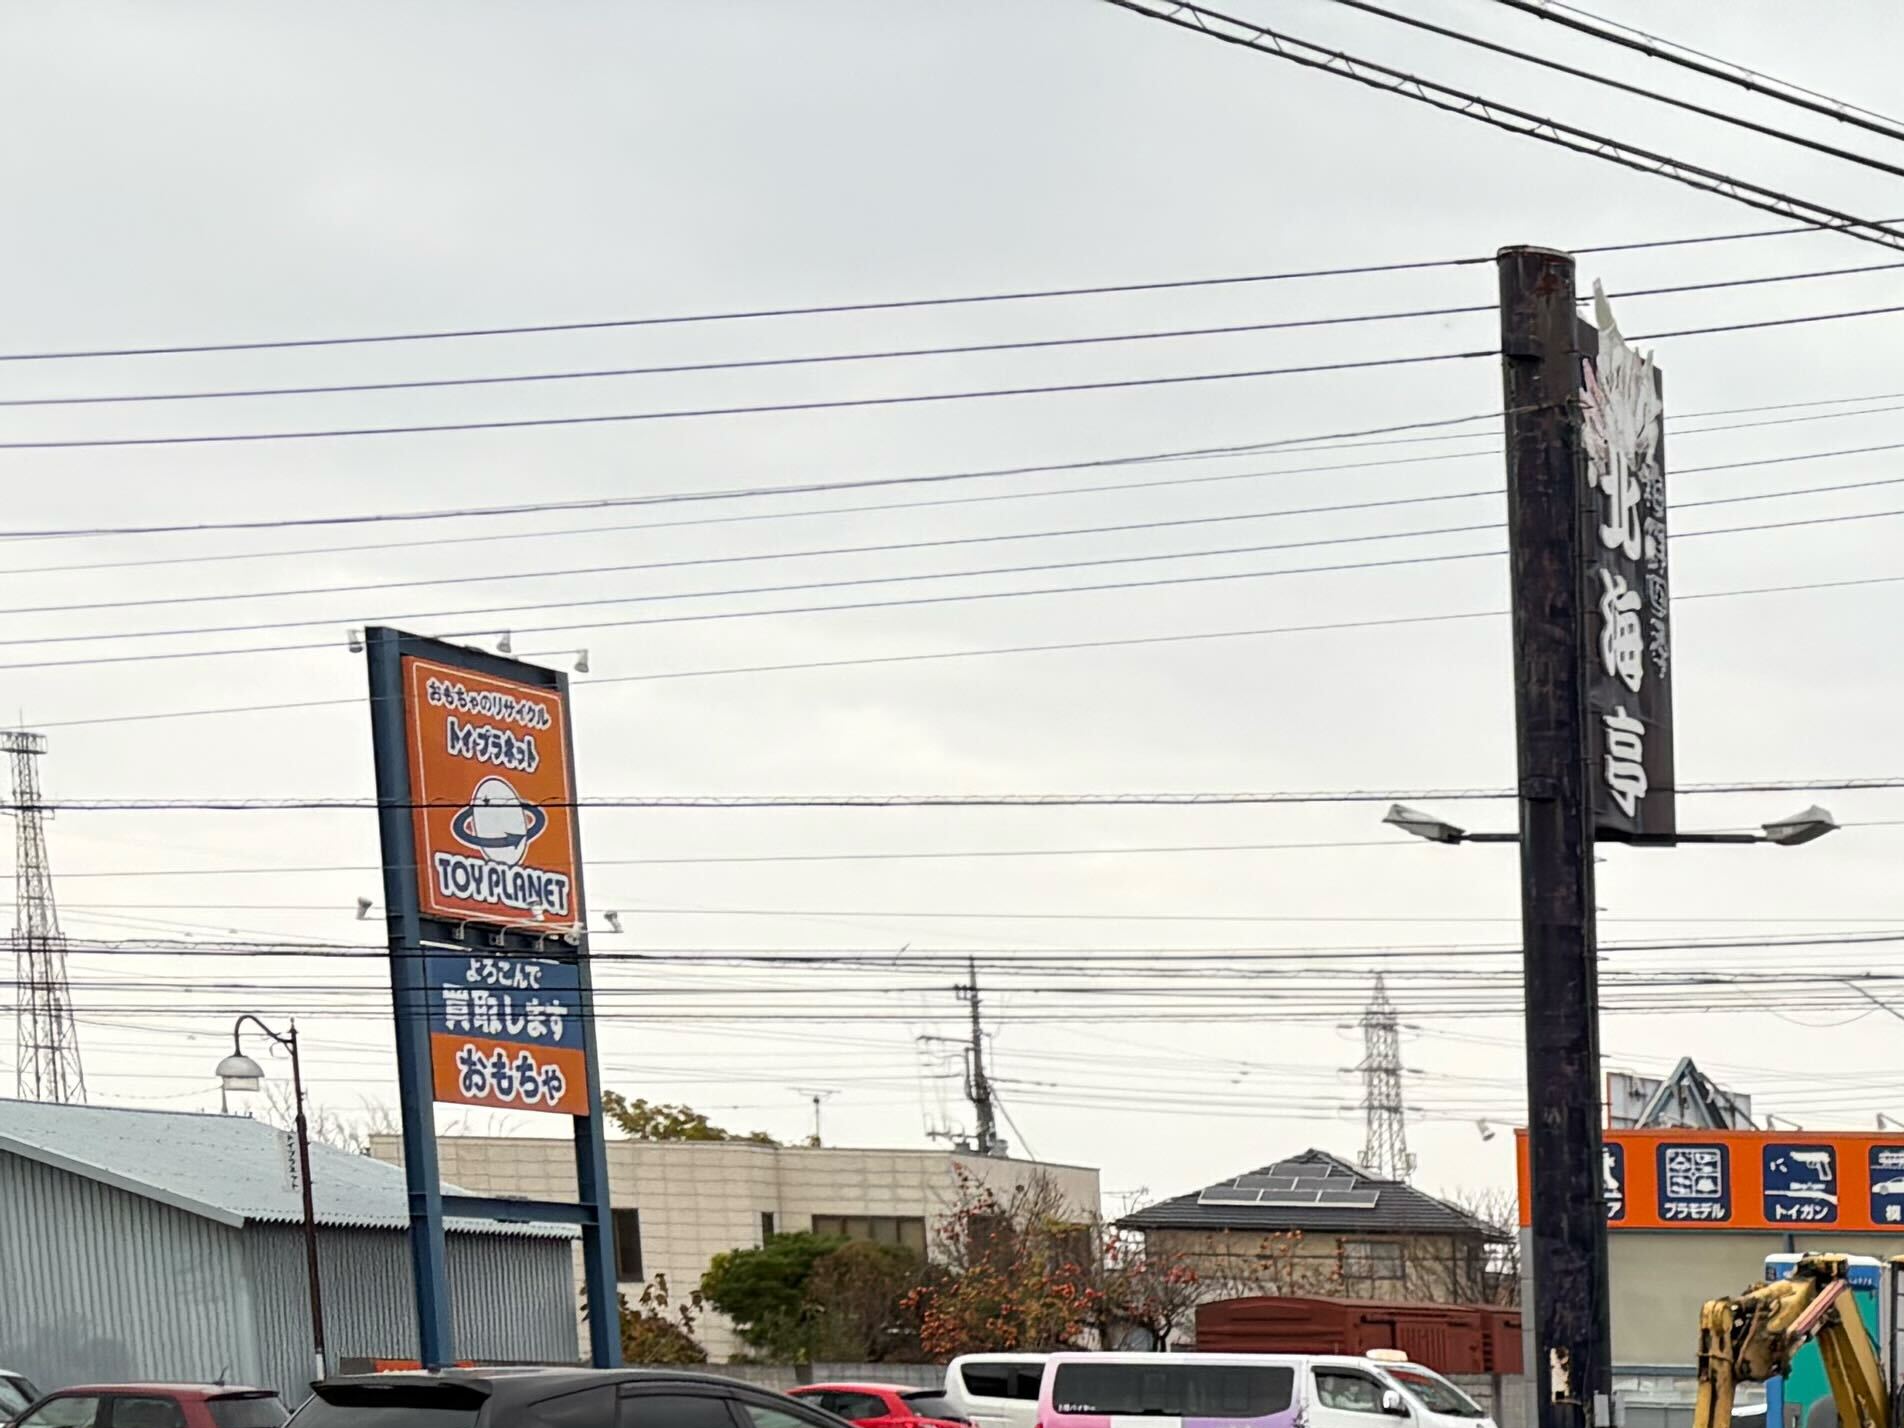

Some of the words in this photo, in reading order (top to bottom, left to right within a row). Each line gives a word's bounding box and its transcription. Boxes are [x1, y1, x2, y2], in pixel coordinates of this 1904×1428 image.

[427, 678, 551, 732] おもちゃのリサイクル
[436, 853, 487, 904] TOY
[487, 861, 569, 915] PLANET
[464, 957, 541, 990] よろこんで
[440, 984, 569, 1042] 買取します
[456, 1043, 566, 1106] おもちゃ
[1664, 1202, 1725, 1220] プラモデル
[1774, 1203, 1828, 1221] トイガン
